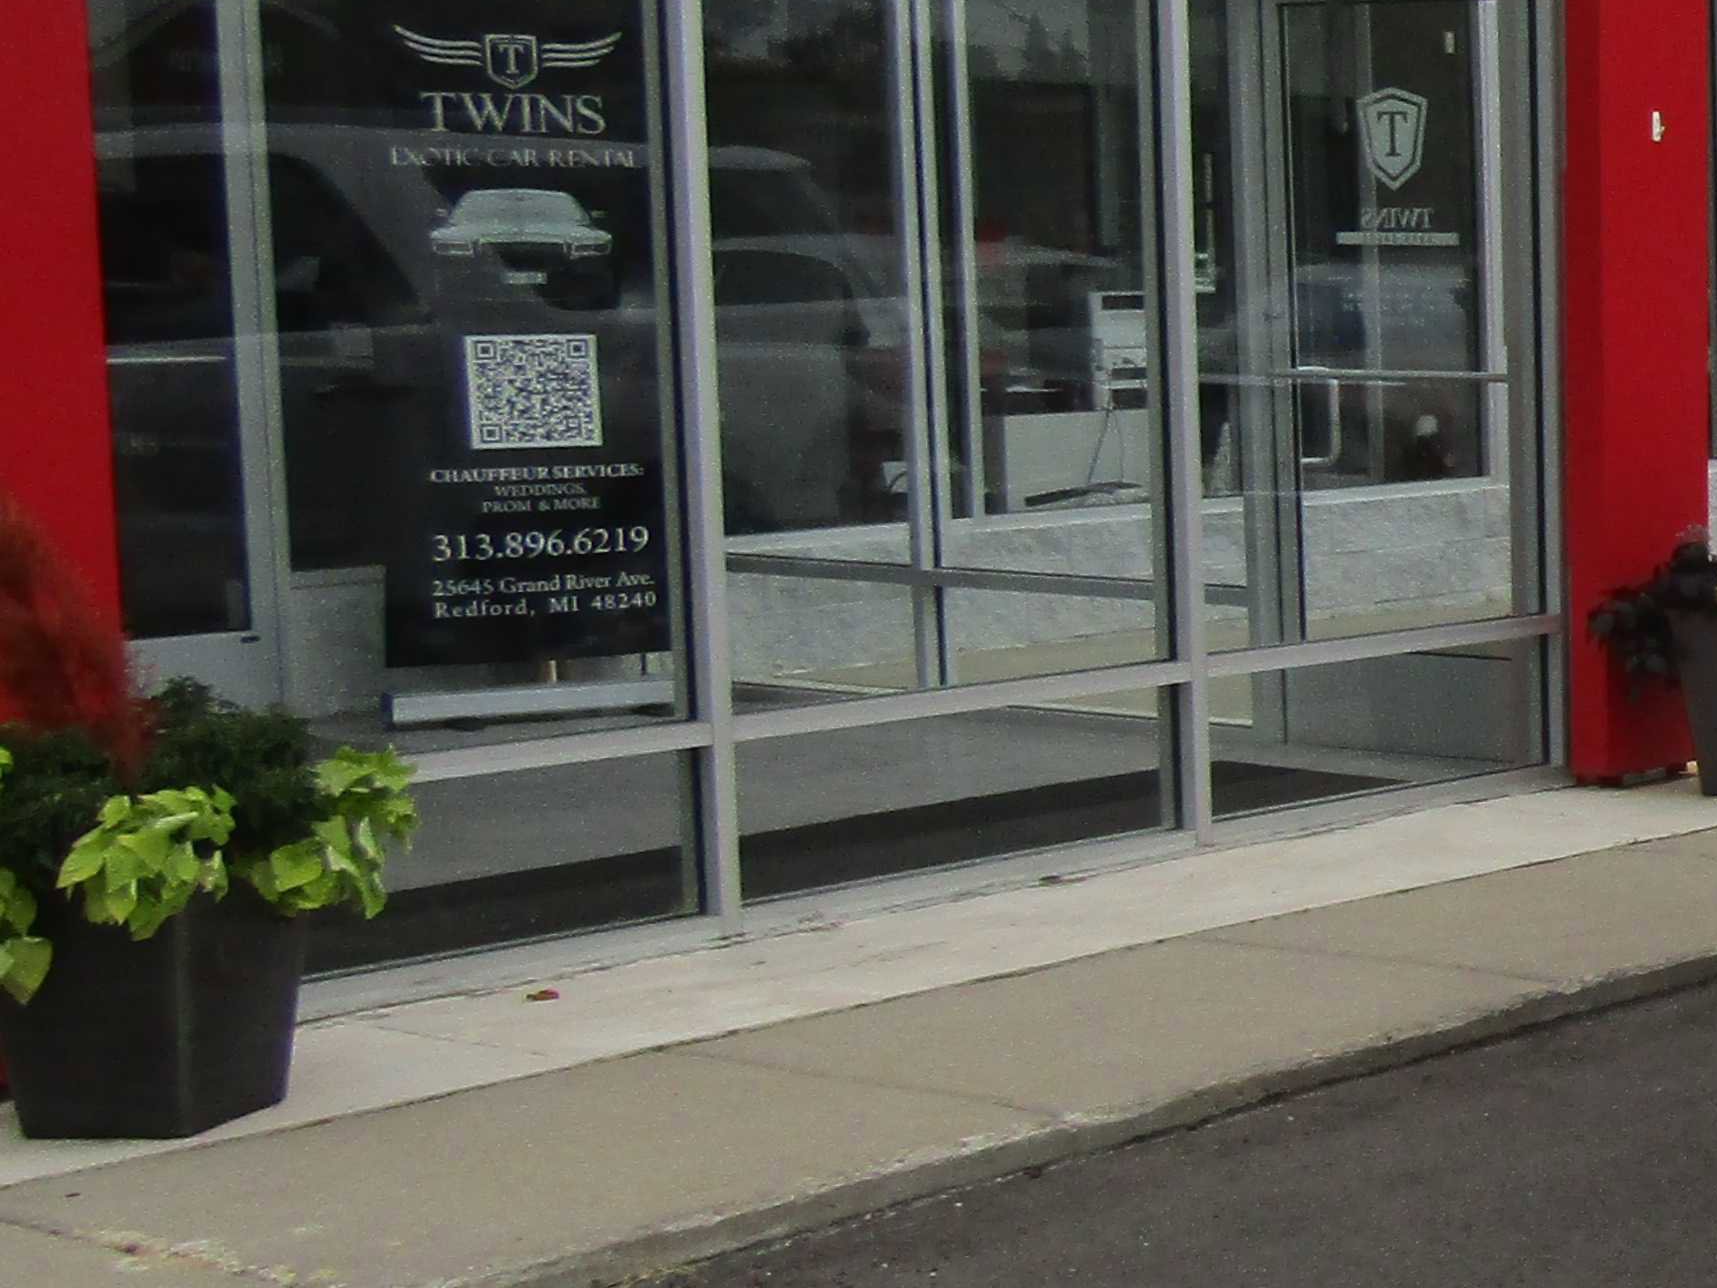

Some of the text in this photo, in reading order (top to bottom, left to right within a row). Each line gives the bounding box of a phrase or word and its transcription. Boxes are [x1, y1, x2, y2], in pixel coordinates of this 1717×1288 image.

[499, 44, 525, 75] T
[418, 91, 606, 135] TWINS
[1376, 111, 1409, 157] T
[487, 149, 539, 168] CAR
[430, 463, 645, 483] CHAUFFEUR SERVICES:
[538, 498, 551, 512] &
[432, 525, 650, 562] 313.896.6219
[432, 570, 656, 597] 25645 Grand River Ave.
[434, 590, 658, 620] Redford, MI 48240
